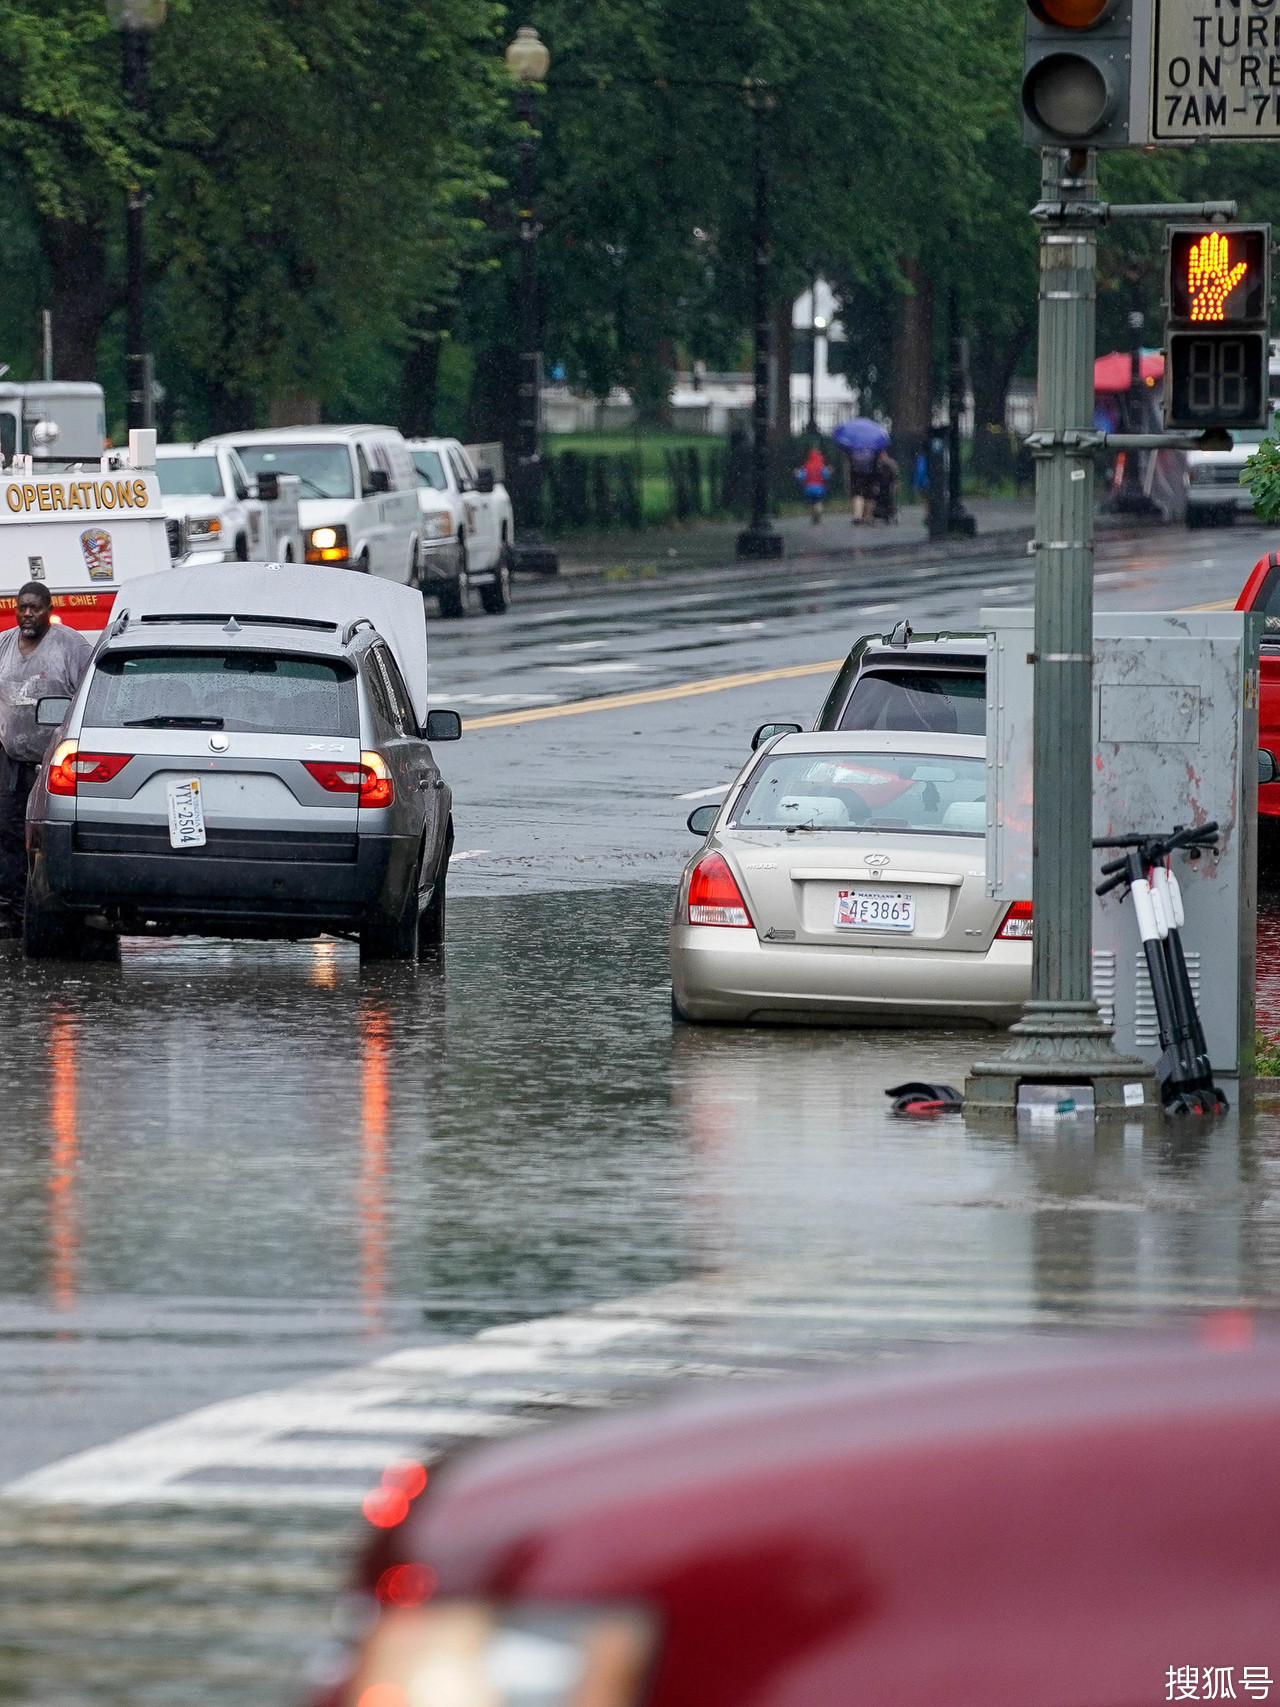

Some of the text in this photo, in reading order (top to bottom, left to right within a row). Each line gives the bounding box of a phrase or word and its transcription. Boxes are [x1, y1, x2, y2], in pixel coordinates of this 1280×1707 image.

[1168, 55, 1221, 87] ON
[1164, 94, 1280, 126] 7AM-7
[6, 479, 149, 512] OPERATIONS
[69, 594, 98, 606] CHIEF
[304, 742, 346, 753] X3
[176, 783, 197, 843] VYY-2504
